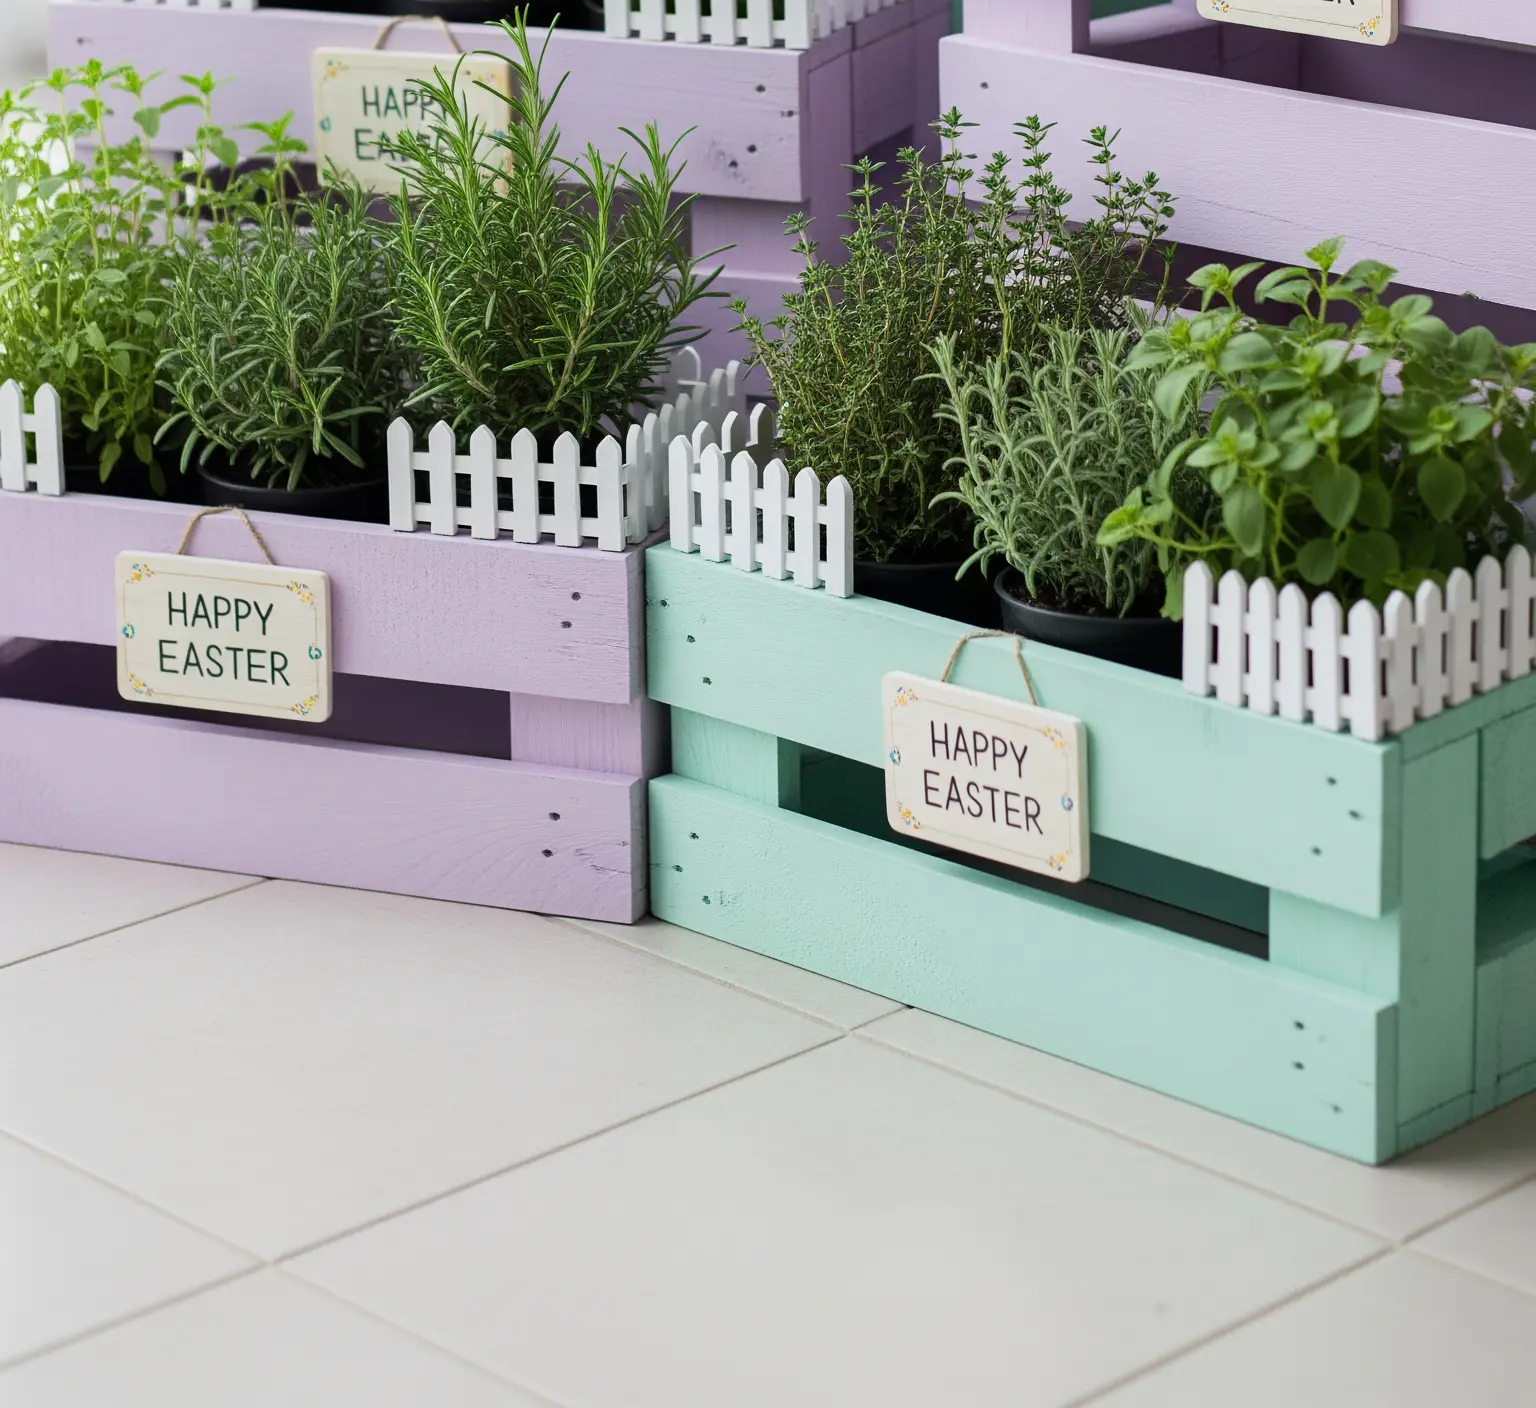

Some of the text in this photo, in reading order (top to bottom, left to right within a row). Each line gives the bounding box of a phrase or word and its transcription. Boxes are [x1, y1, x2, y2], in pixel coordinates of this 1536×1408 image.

[168, 591, 274, 636] HAPPY
[158, 639, 290, 687] EASTER
[930, 720, 1028, 779] HAPPY
[923, 768, 1044, 835] EASTER
